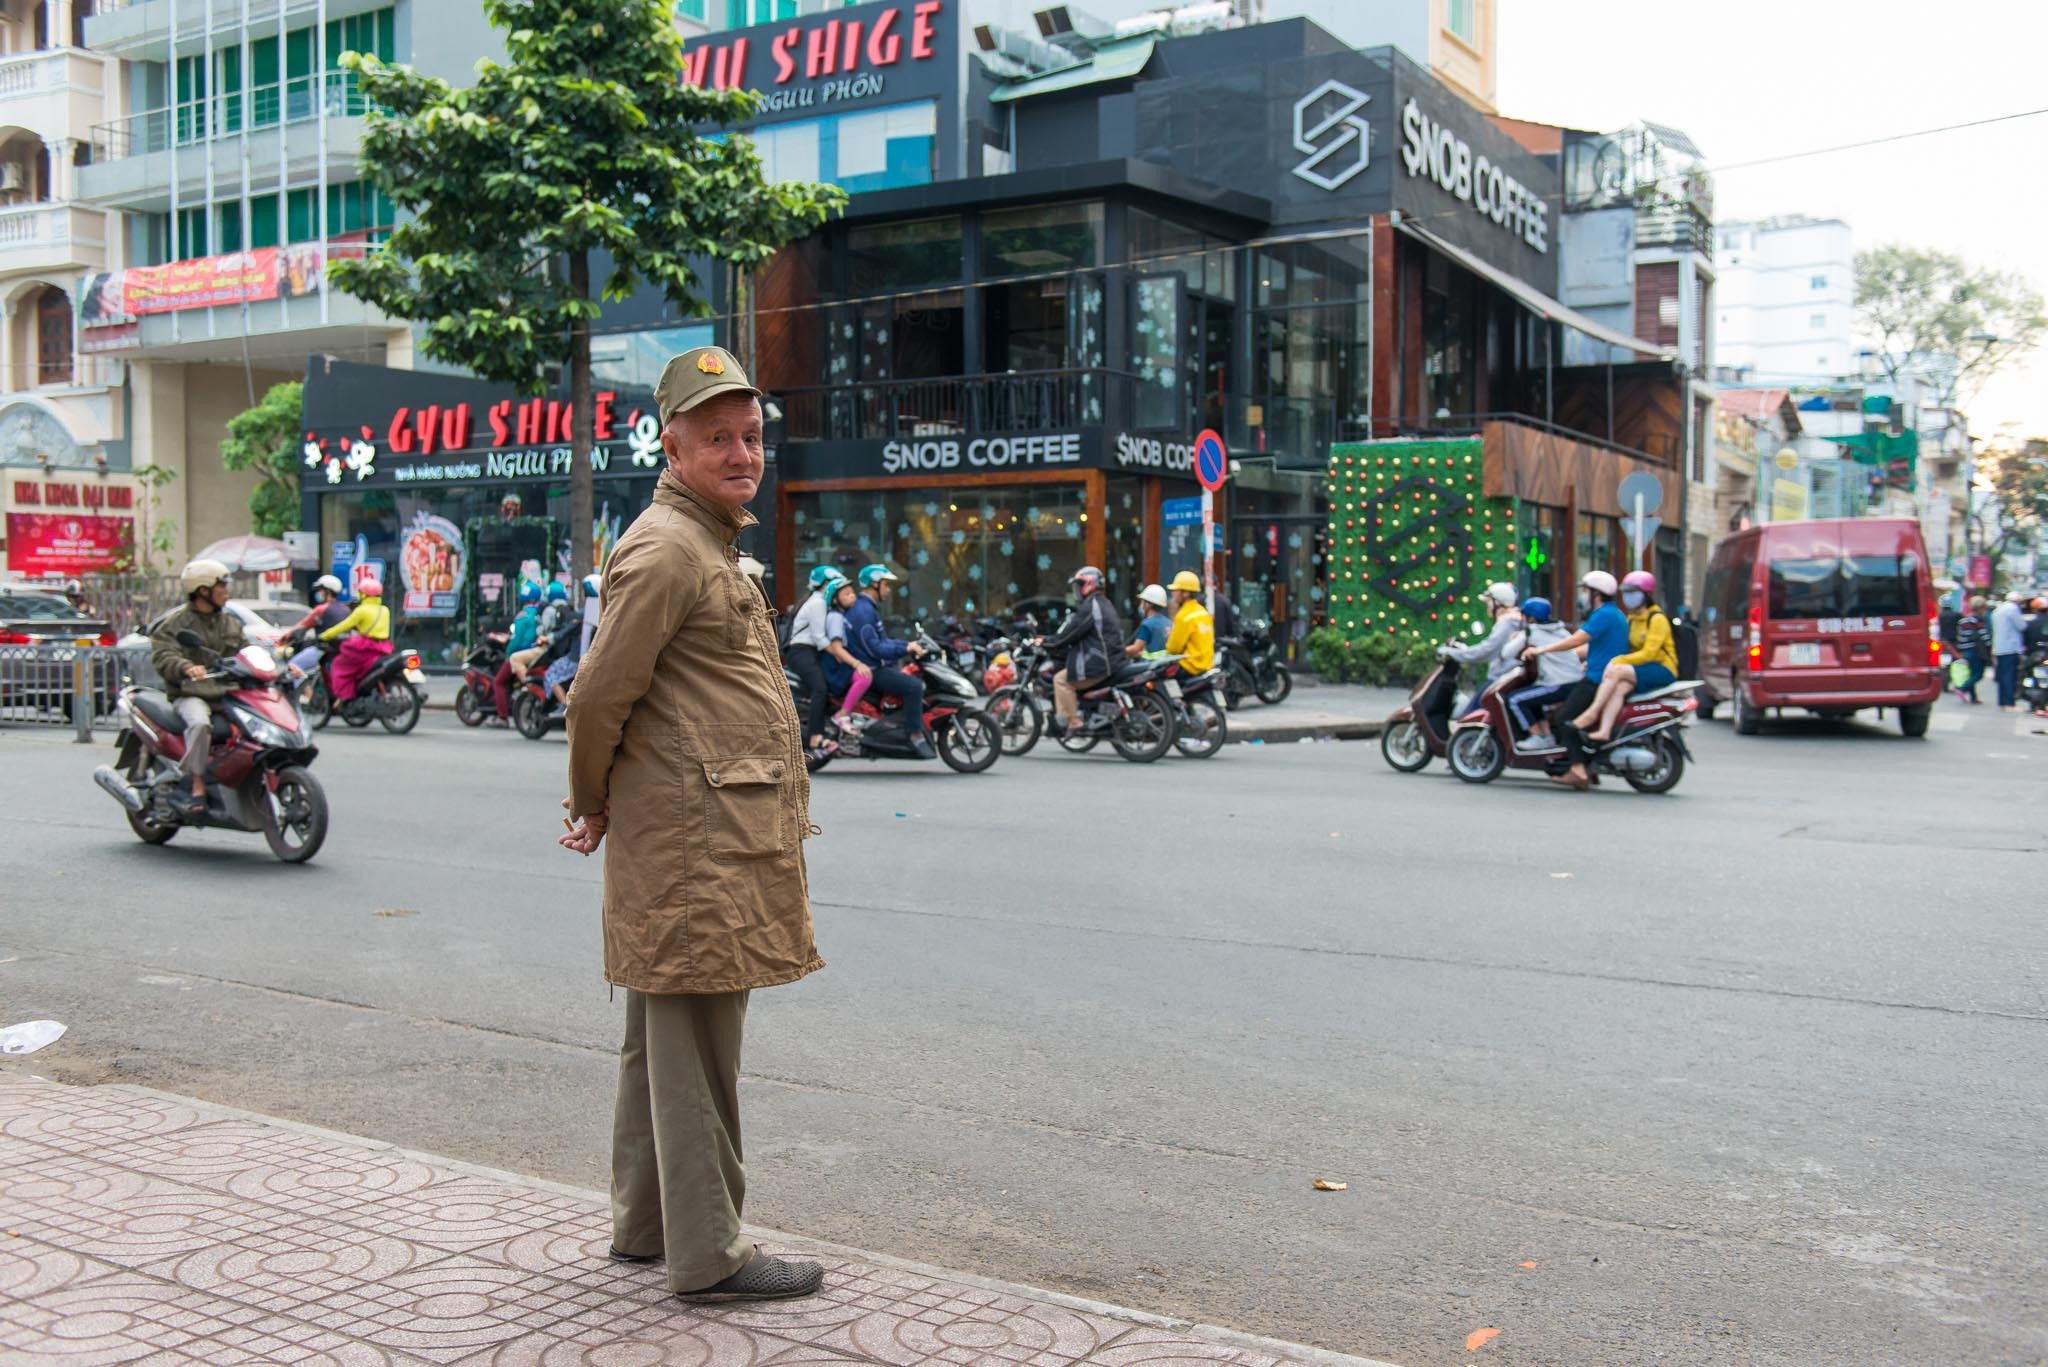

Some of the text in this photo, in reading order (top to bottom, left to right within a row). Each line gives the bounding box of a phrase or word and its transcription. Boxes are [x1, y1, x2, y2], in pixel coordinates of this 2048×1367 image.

[682, 0, 942, 93] YU SHIGE
[1474, 155, 1548, 254] COFFEE
[388, 403, 471, 455] GYU
[967, 434, 1081, 467] COFFEE
